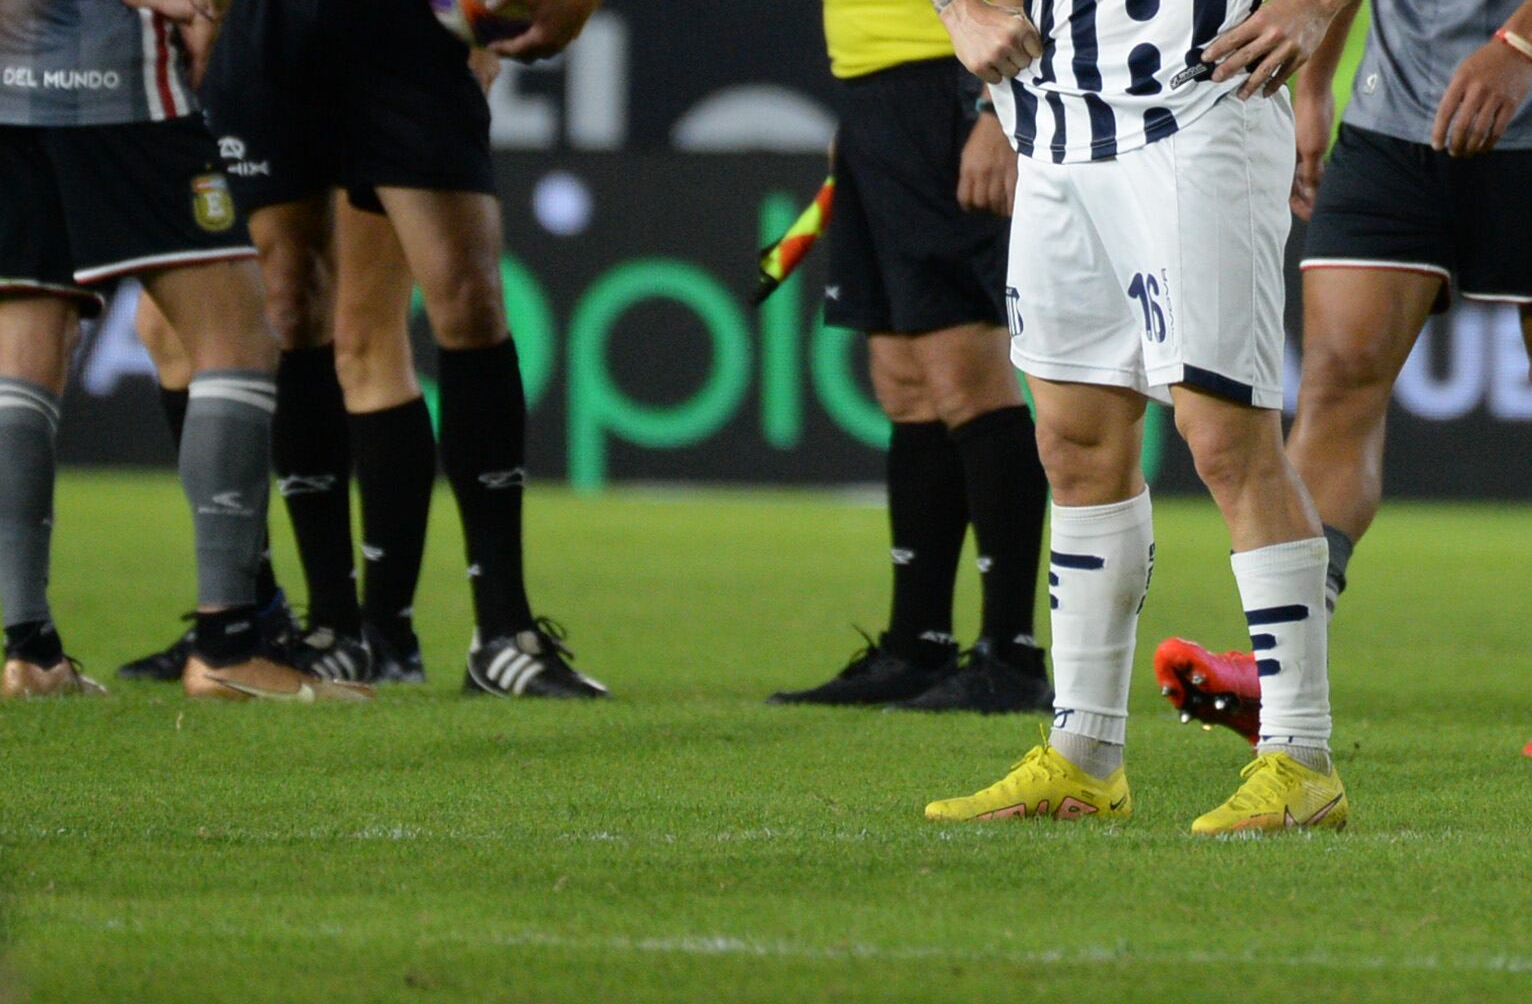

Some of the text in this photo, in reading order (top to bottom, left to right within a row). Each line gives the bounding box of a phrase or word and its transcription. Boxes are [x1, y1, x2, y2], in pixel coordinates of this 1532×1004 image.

[3, 66, 121, 90] DEL MUNDO
[1127, 272, 1167, 343] 16
